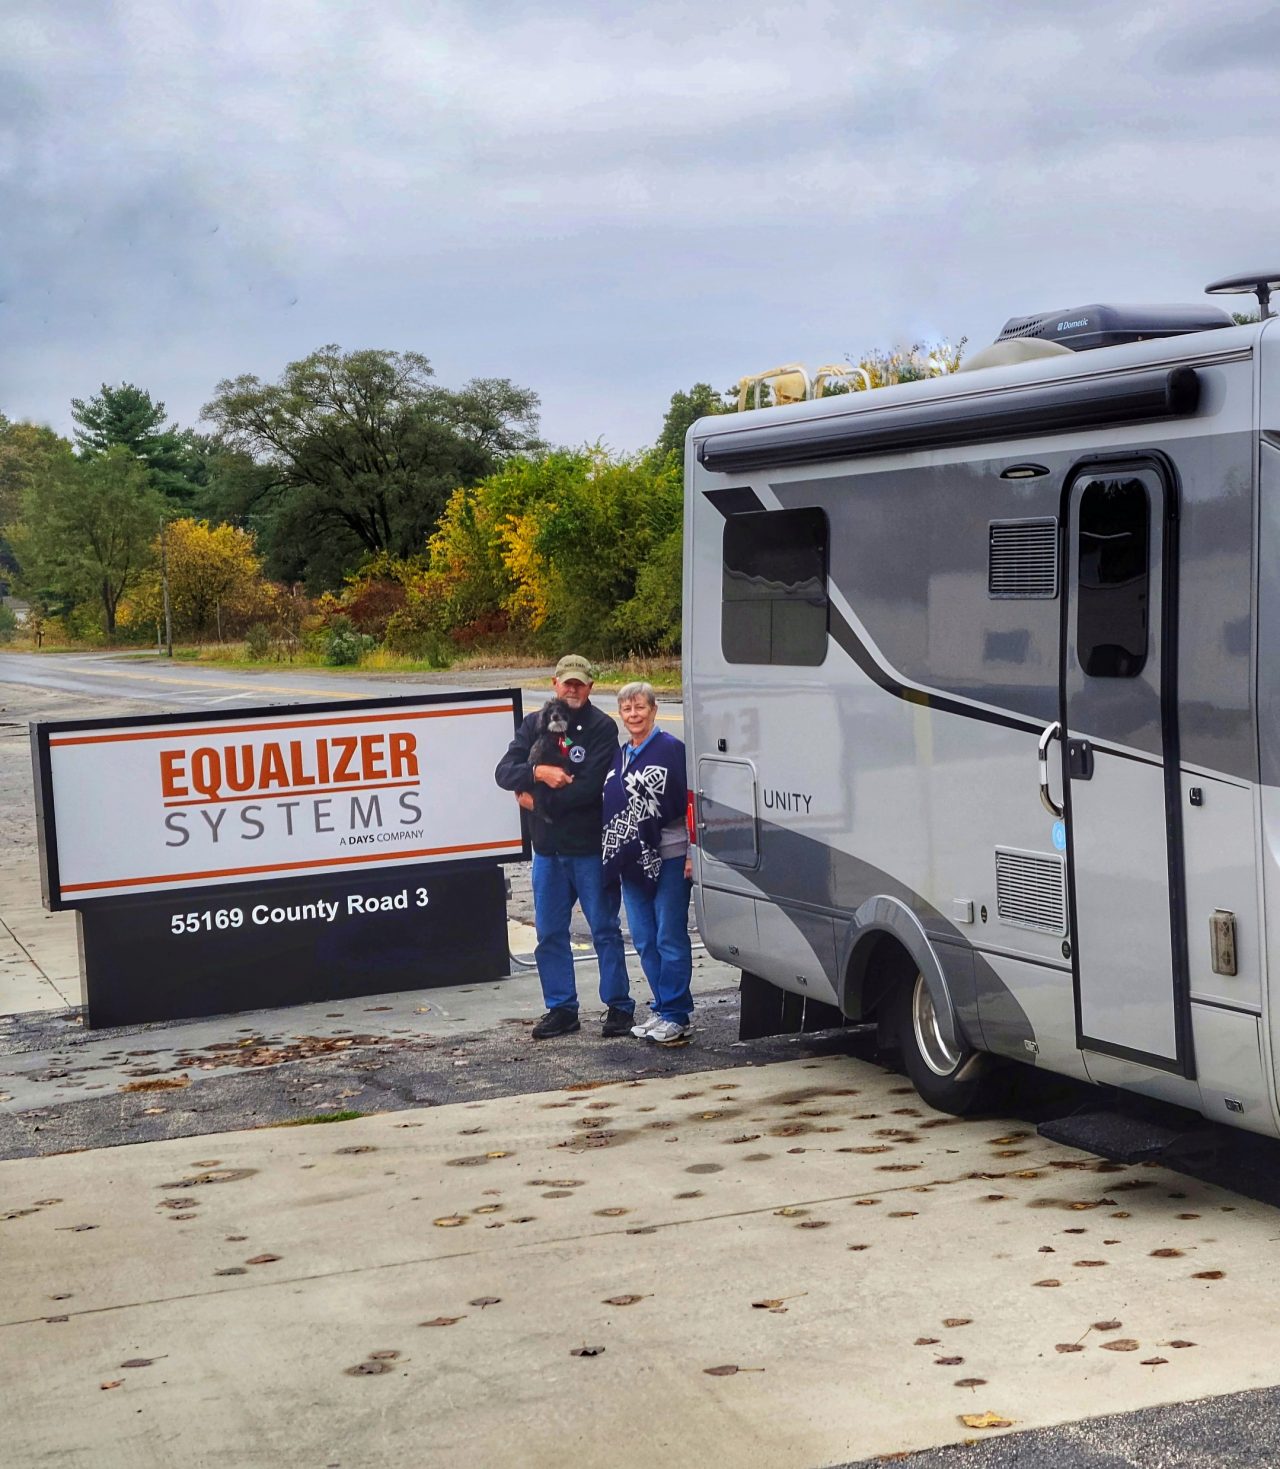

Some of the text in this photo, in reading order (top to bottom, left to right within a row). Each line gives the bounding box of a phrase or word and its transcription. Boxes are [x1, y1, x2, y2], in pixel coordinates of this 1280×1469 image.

[1063, 317, 1089, 330] Dometic
[160, 732, 419, 801] EQUALIZER
[164, 791, 422, 847] SYSTEMS
[763, 789, 812, 814] UNITY
[340, 829, 424, 846] A DAYS COMPANY
[171, 887, 429, 935] 55169 County Road 3
